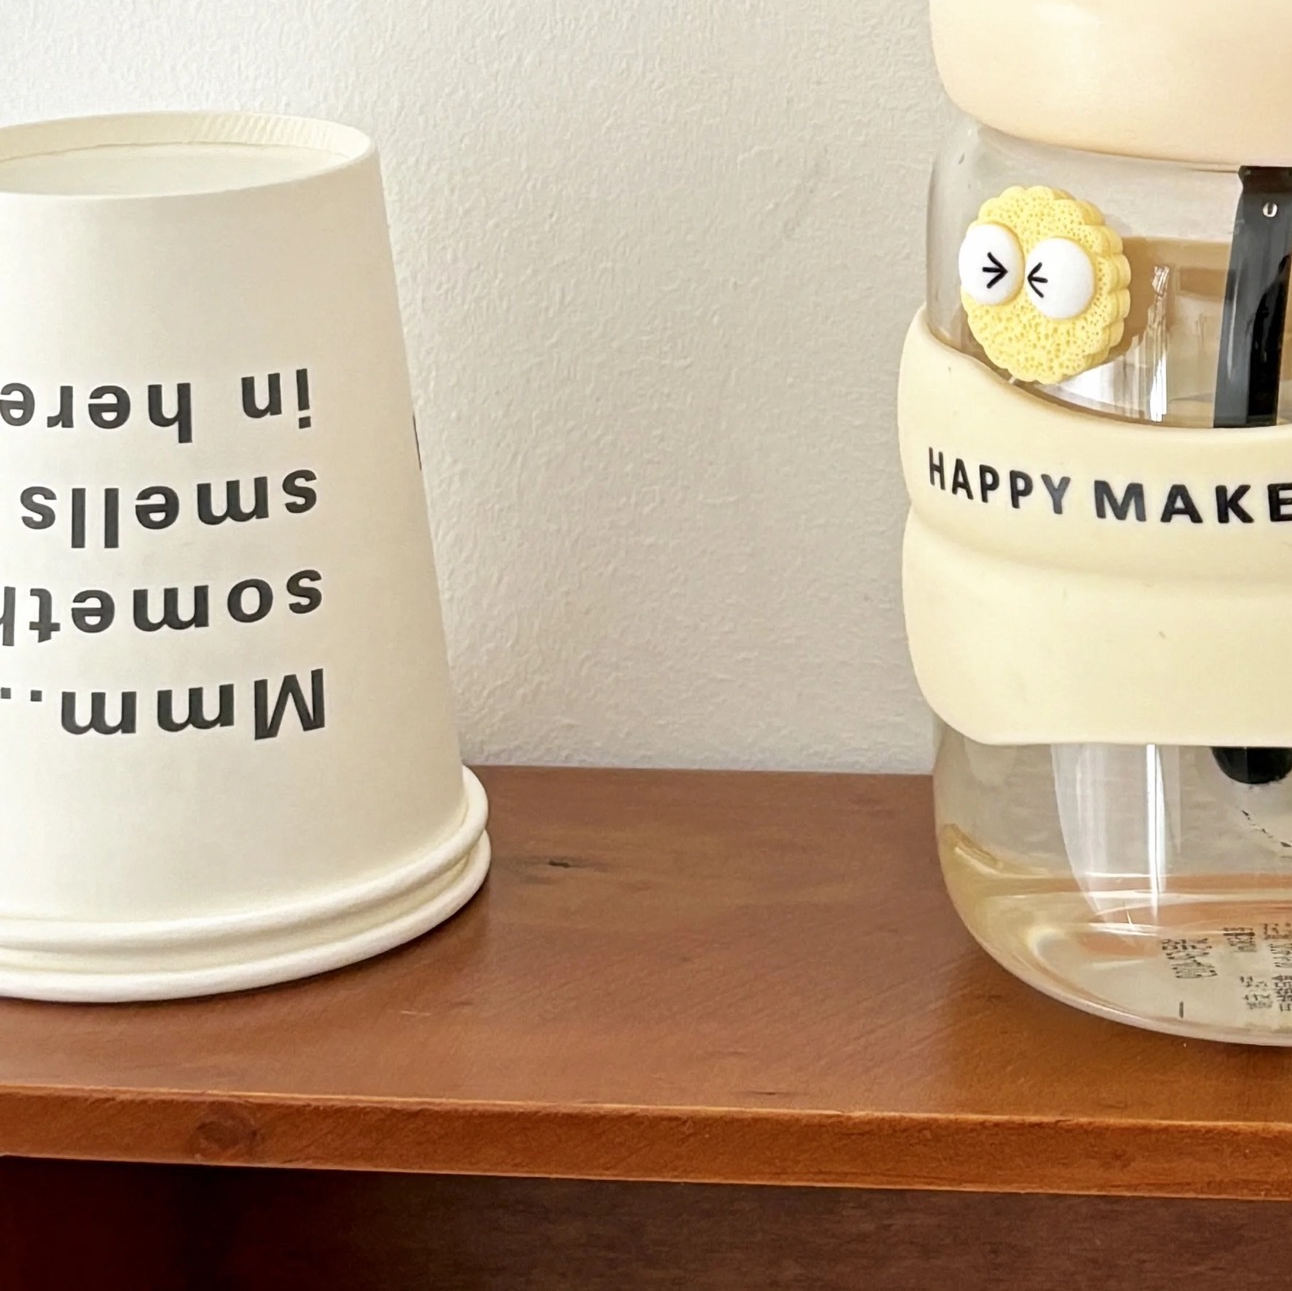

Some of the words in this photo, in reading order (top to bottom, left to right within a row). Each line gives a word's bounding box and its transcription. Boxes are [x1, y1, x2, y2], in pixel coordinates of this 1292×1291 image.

[0, 382, 193, 444] here
[241, 368, 312, 429] in
[19, 469, 318, 549] smells
[928, 447, 1073, 515] HAPPY
